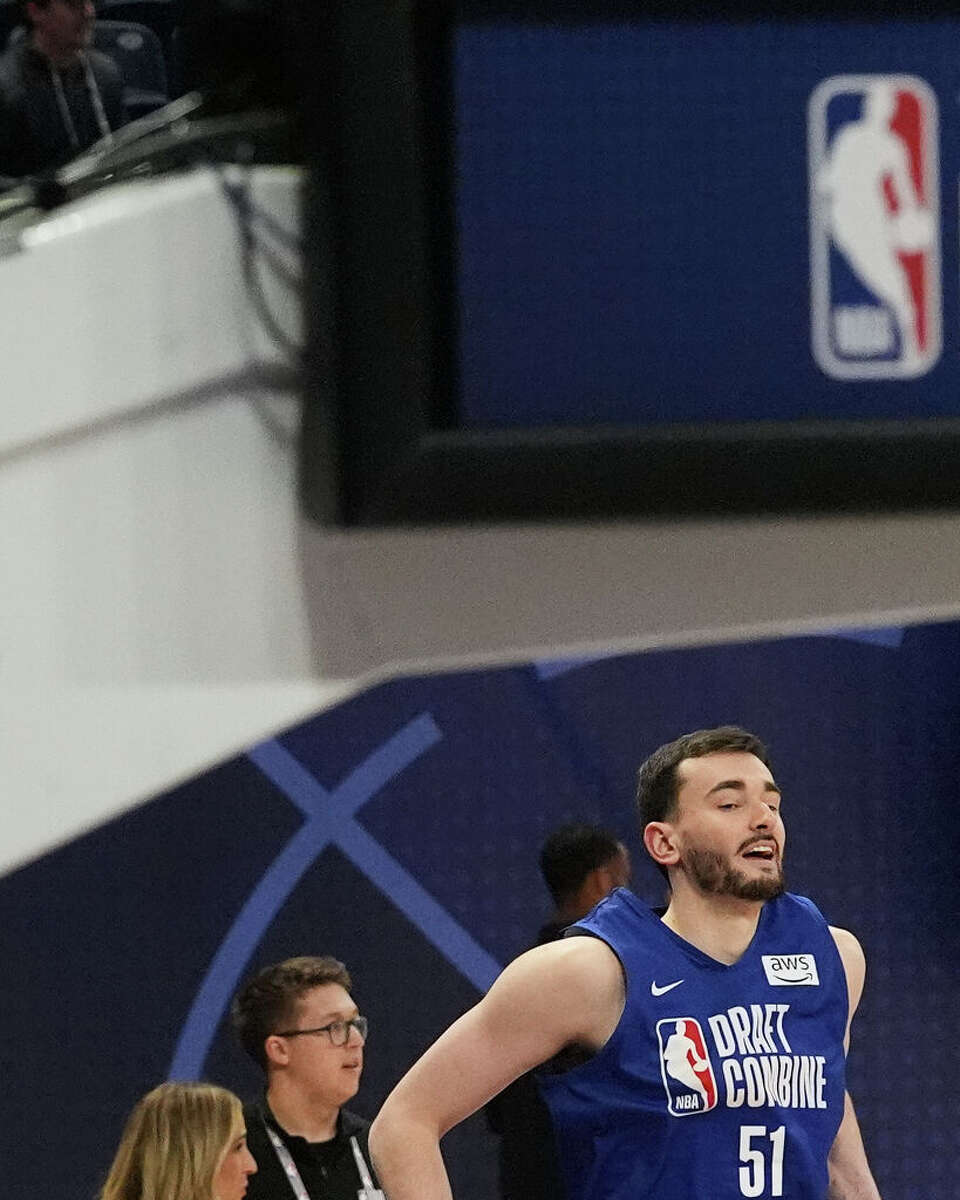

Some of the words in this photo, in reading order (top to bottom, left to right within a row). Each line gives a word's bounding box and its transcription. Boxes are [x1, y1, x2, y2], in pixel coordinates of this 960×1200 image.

[771, 955, 810, 972] aws
[707, 1003, 793, 1058] DRAFT
[675, 1093, 700, 1111] NBA
[721, 1055, 828, 1109] COMBINE
[738, 1125, 786, 1198] 51
